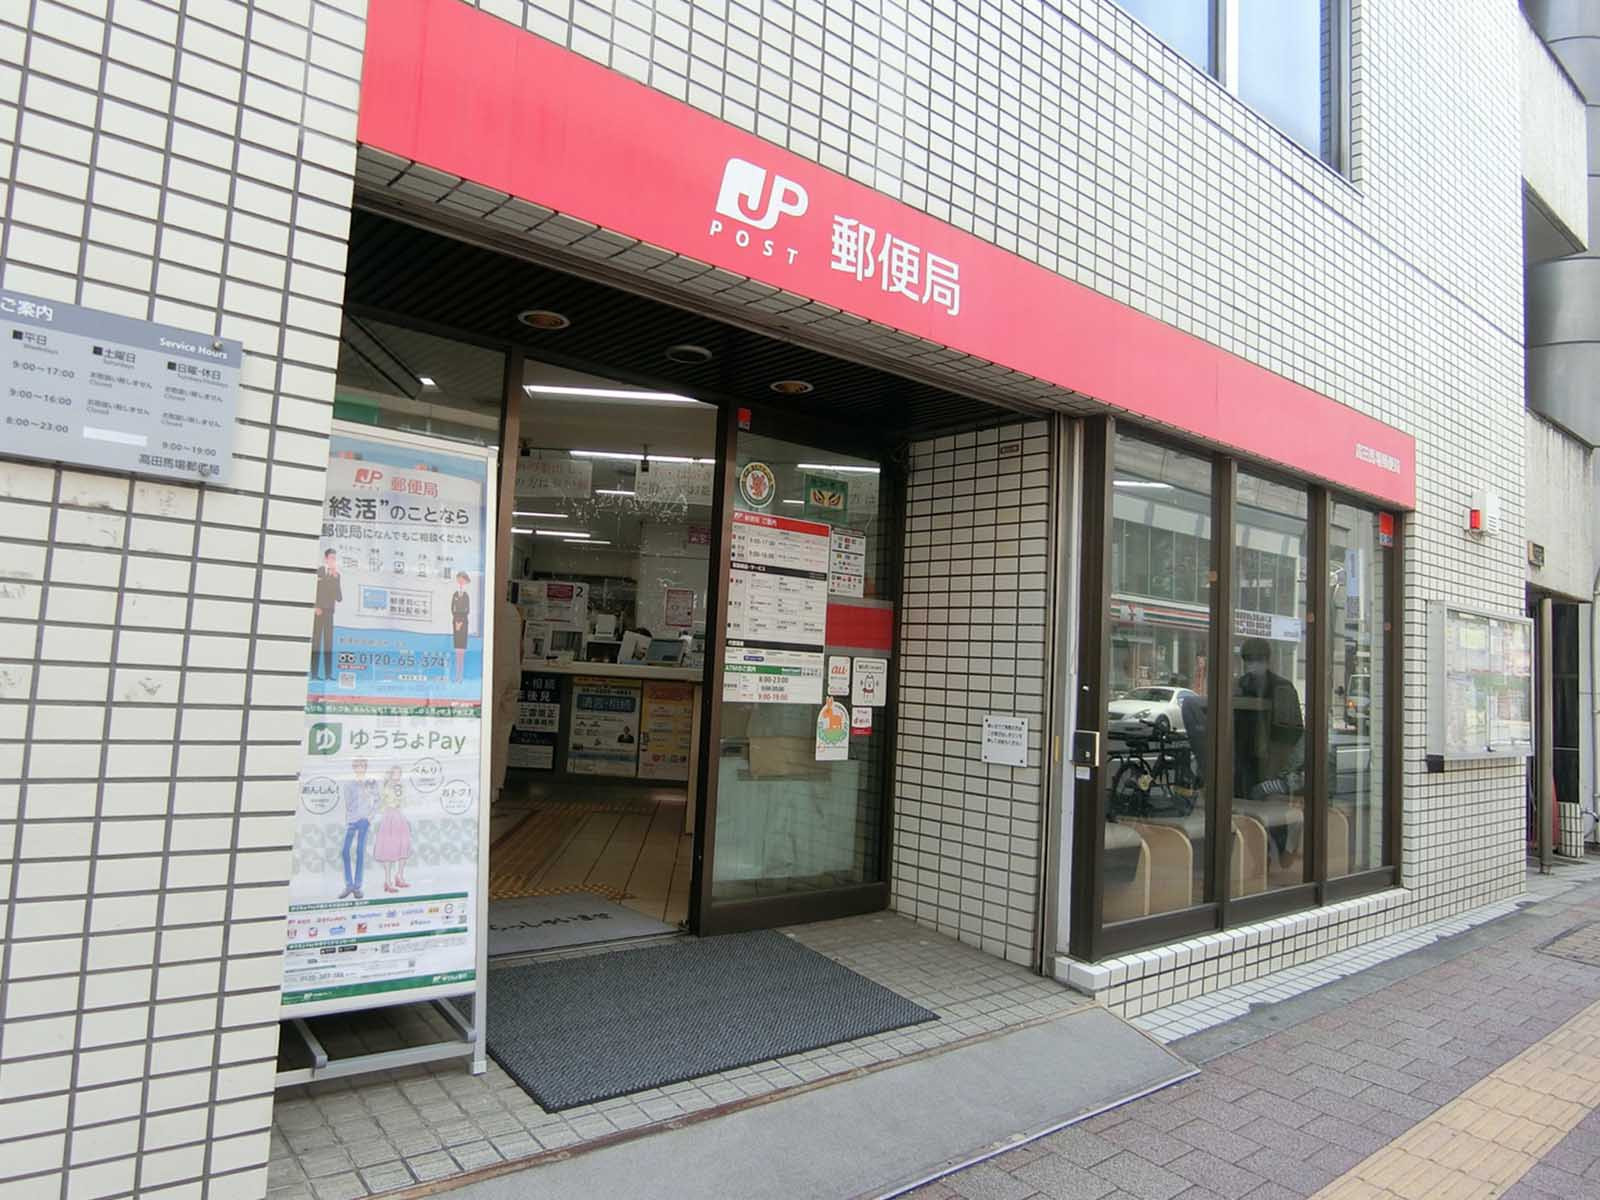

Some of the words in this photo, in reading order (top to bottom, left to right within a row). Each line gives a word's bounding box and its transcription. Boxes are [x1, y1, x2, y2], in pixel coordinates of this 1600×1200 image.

[715, 157, 809, 230] JP
[709, 220, 799, 265] POST
[830, 214, 961, 316] 郵便局
[0, 297, 53, 321] ご案内
[24, 331, 48, 345] 平日
[159, 337, 196, 352] Service
[197, 345, 228, 360] Hours
[103, 349, 136, 363] 土曜日
[391, 477, 439, 498] 郵便局
[349, 728, 467, 754] ゆうちょPay
